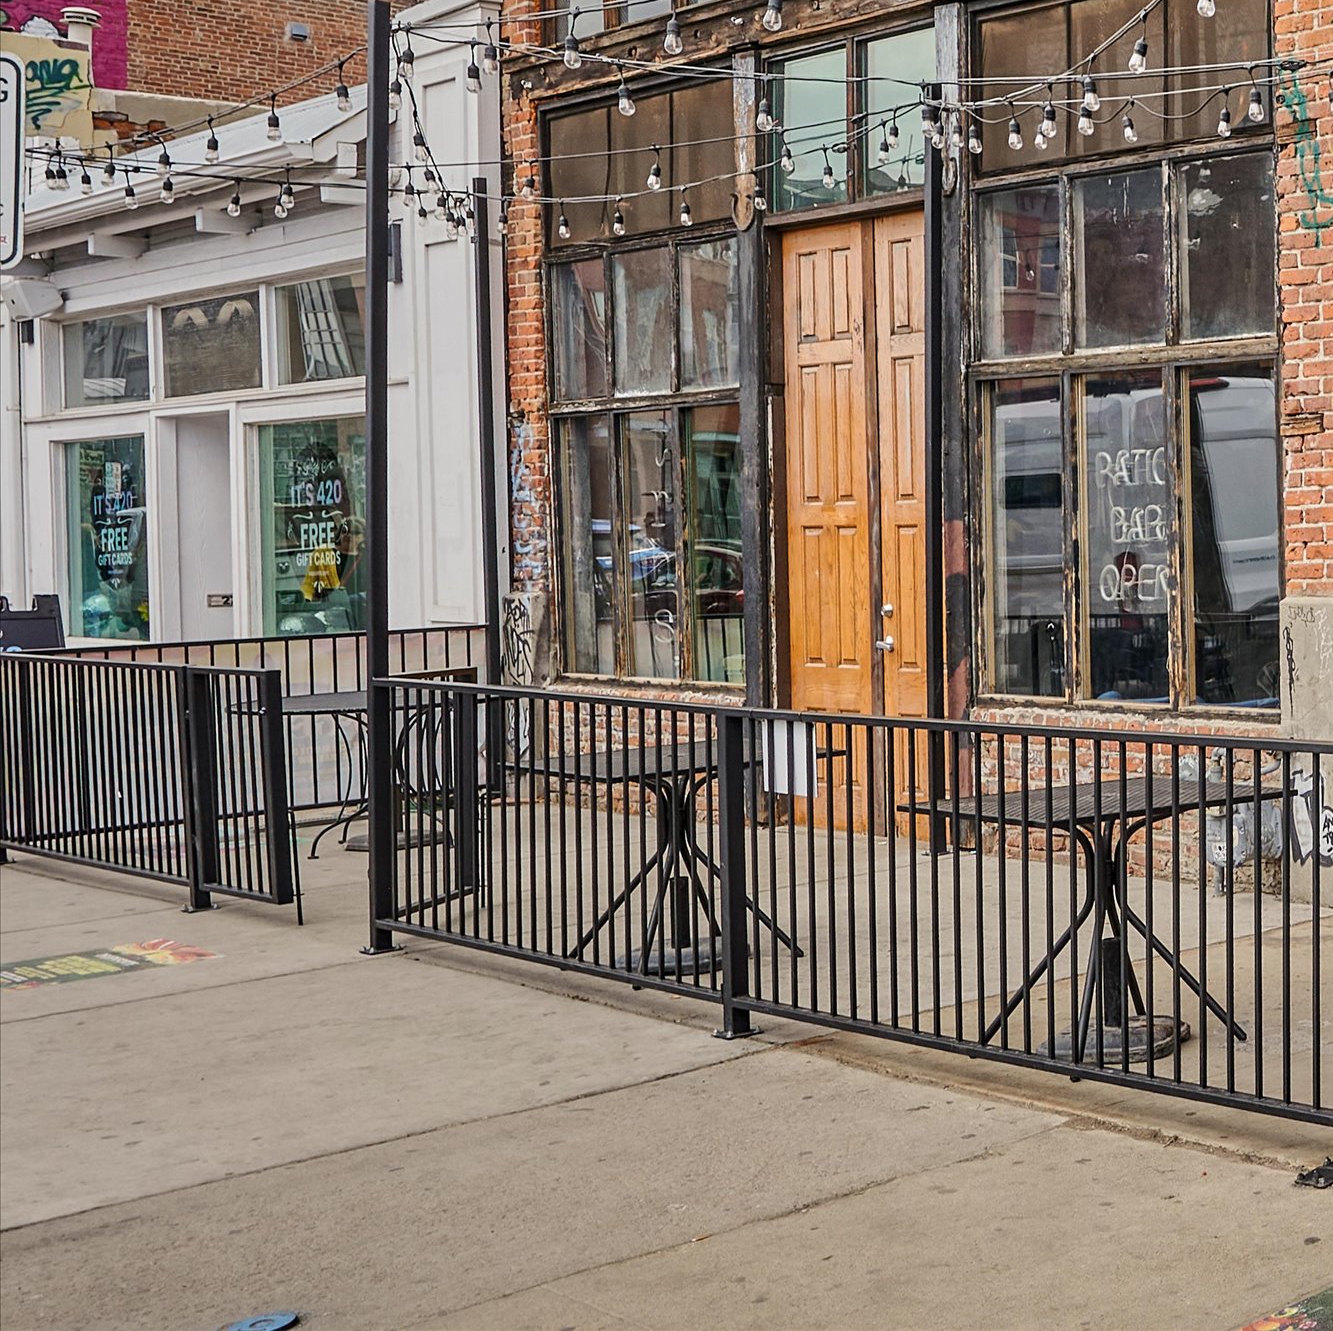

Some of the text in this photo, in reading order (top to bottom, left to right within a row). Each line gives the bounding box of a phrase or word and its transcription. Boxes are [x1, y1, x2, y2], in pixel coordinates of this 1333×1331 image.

[290, 479, 343, 508] IT'S 420
[101, 527, 129, 552] FREE
[300, 521, 336, 549] FREE
[98, 551, 133, 567] GIFT CARDS
[296, 550, 342, 567] GIFT CARDS
